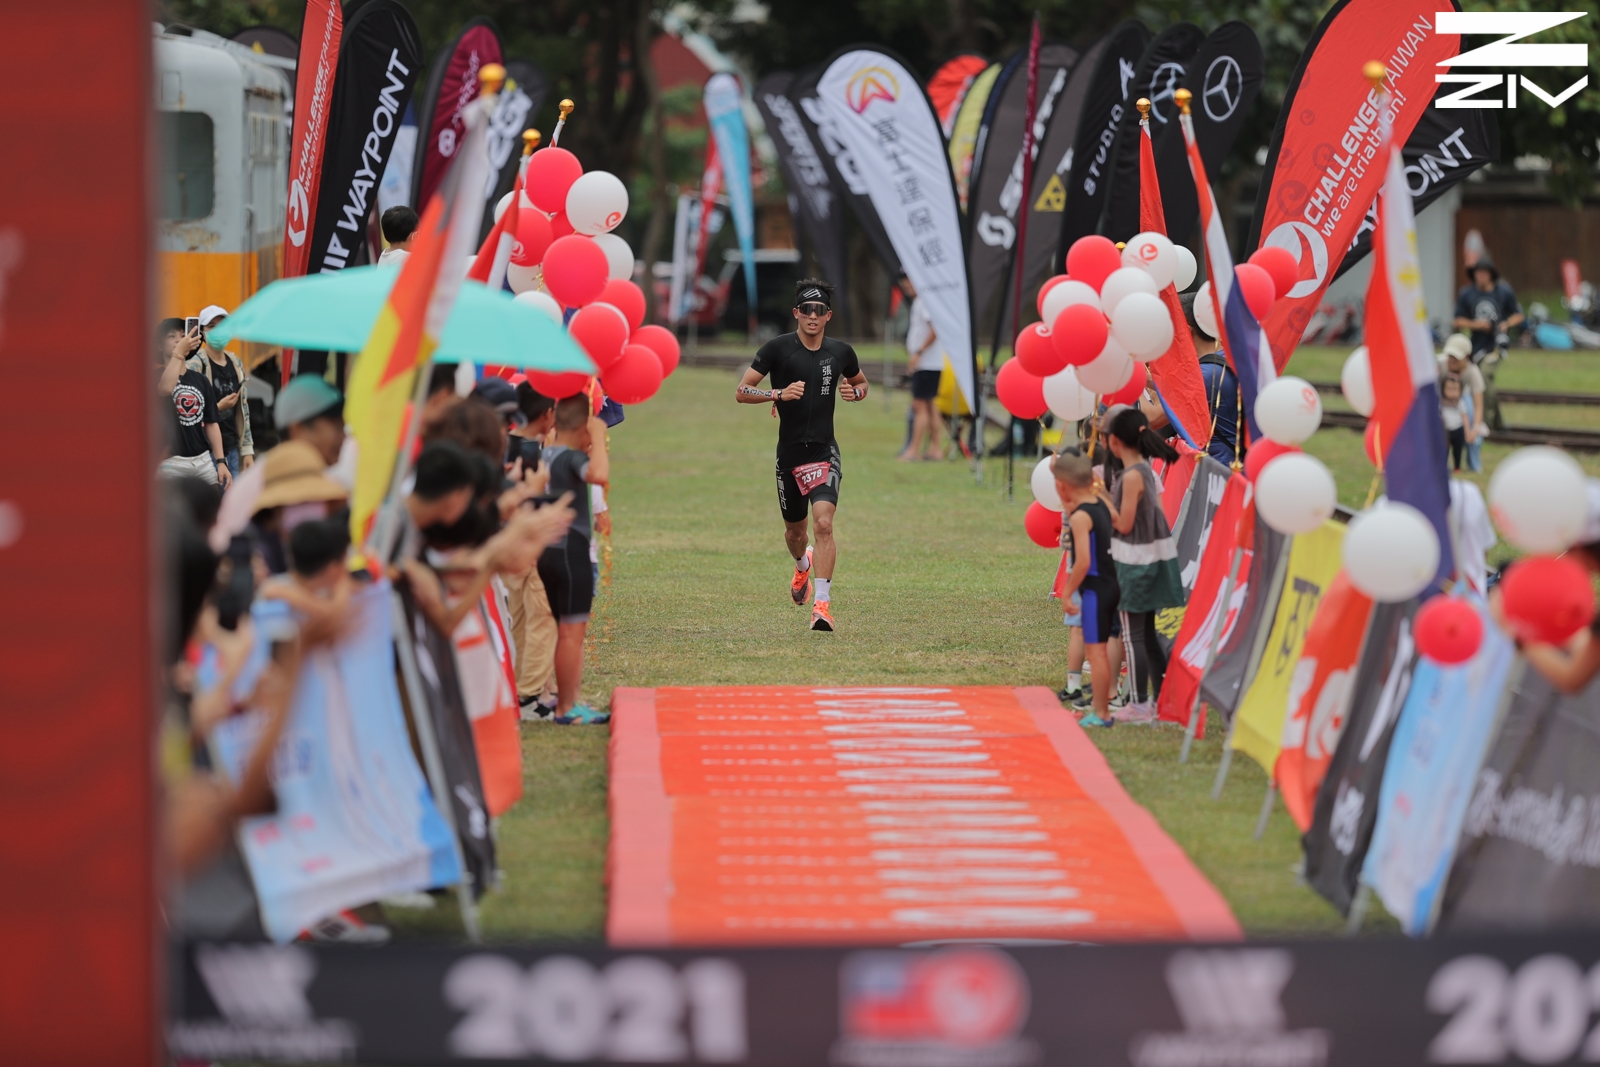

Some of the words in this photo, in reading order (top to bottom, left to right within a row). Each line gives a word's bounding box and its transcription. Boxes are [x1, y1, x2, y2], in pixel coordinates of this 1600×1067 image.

[298, 61, 325, 183] CHALLENGE
[336, 47, 410, 232] WAYPOINT
[1083, 103, 1125, 197] STUDIO
[1303, 86, 1384, 225] CHALLENGE
[1379, 14, 1434, 95] TAIWAN
[1320, 208, 1342, 238] we
[1339, 176, 1358, 209] are
[1349, 89, 1407, 180] triathlon!
[821, 365, 832, 396] 張家班
[801, 468, 823, 485] 2378
[443, 953, 747, 1062] 2021
